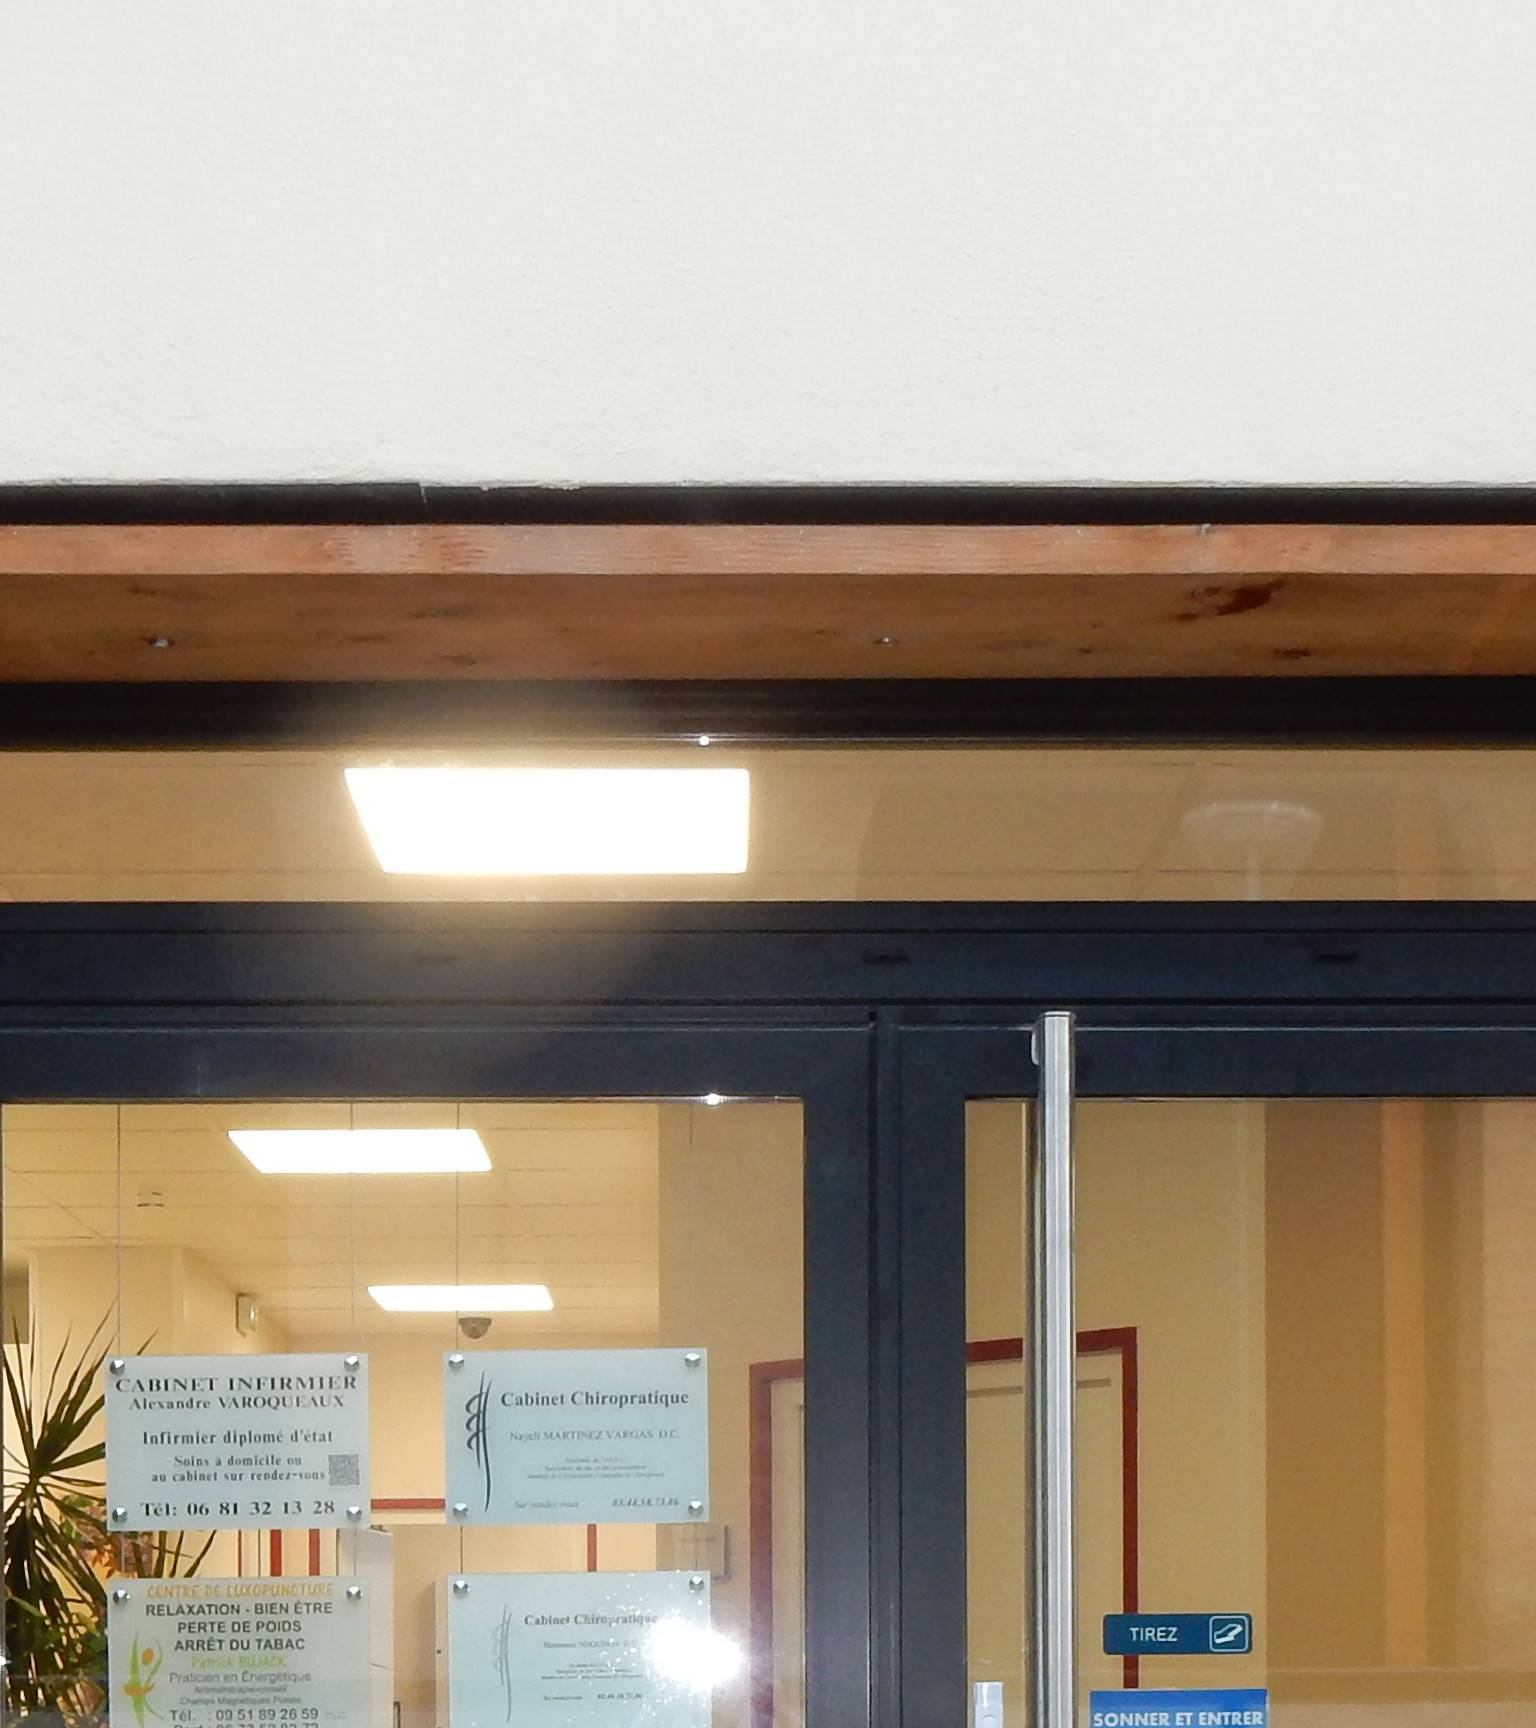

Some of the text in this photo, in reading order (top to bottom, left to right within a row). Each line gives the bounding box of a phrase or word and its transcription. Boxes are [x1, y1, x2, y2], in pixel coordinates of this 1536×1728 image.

[115, 1376, 357, 1392] CABINET INFIRMIER
[129, 1395, 345, 1410] Alexandre VAROQUEAUX
[501, 1390, 689, 1408] Cabinet Chiropratique
[143, 1431, 216, 1445] Infirmier
[290, 1429, 333, 1443] d'état
[544, 1431, 602, 1441] MARTINEZ
[174, 1455, 209, 1467] Soins
[228, 1454, 281, 1466] domicile
[287, 1457, 302, 1466] ou
[152, 1470, 325, 1482] au cabinet sur rendez-vous
[187, 1502, 209, 1516] 06
[219, 1502, 239, 1516] 81
[250, 1501, 272, 1516] 32
[283, 1501, 302, 1515] 13
[313, 1500, 335, 1514] 28
[147, 1583, 334, 1598] CENTRE DE LUXOPUNCTURE
[146, 1603, 240, 1617] RELAXATION
[254, 1602, 289, 1615] BIEN
[294, 1600, 333, 1614] ÊTRE
[177, 1620, 302, 1634] PERTE DE POIDS
[524, 1613, 658, 1627] Cabinet Chiropratique
[1129, 1626, 1178, 1642] TIREZ
[174, 1636, 305, 1651] ARRÊT DU TABAC
[169, 1670, 312, 1684] Praticien en Énergétique
[215, 1708, 233, 1721] 09
[237, 1708, 254, 1720] 51
[258, 1708, 276, 1720] 89
[301, 1707, 319, 1719] 59
[1093, 1711, 1263, 1727] SONNER ET ENTRER
